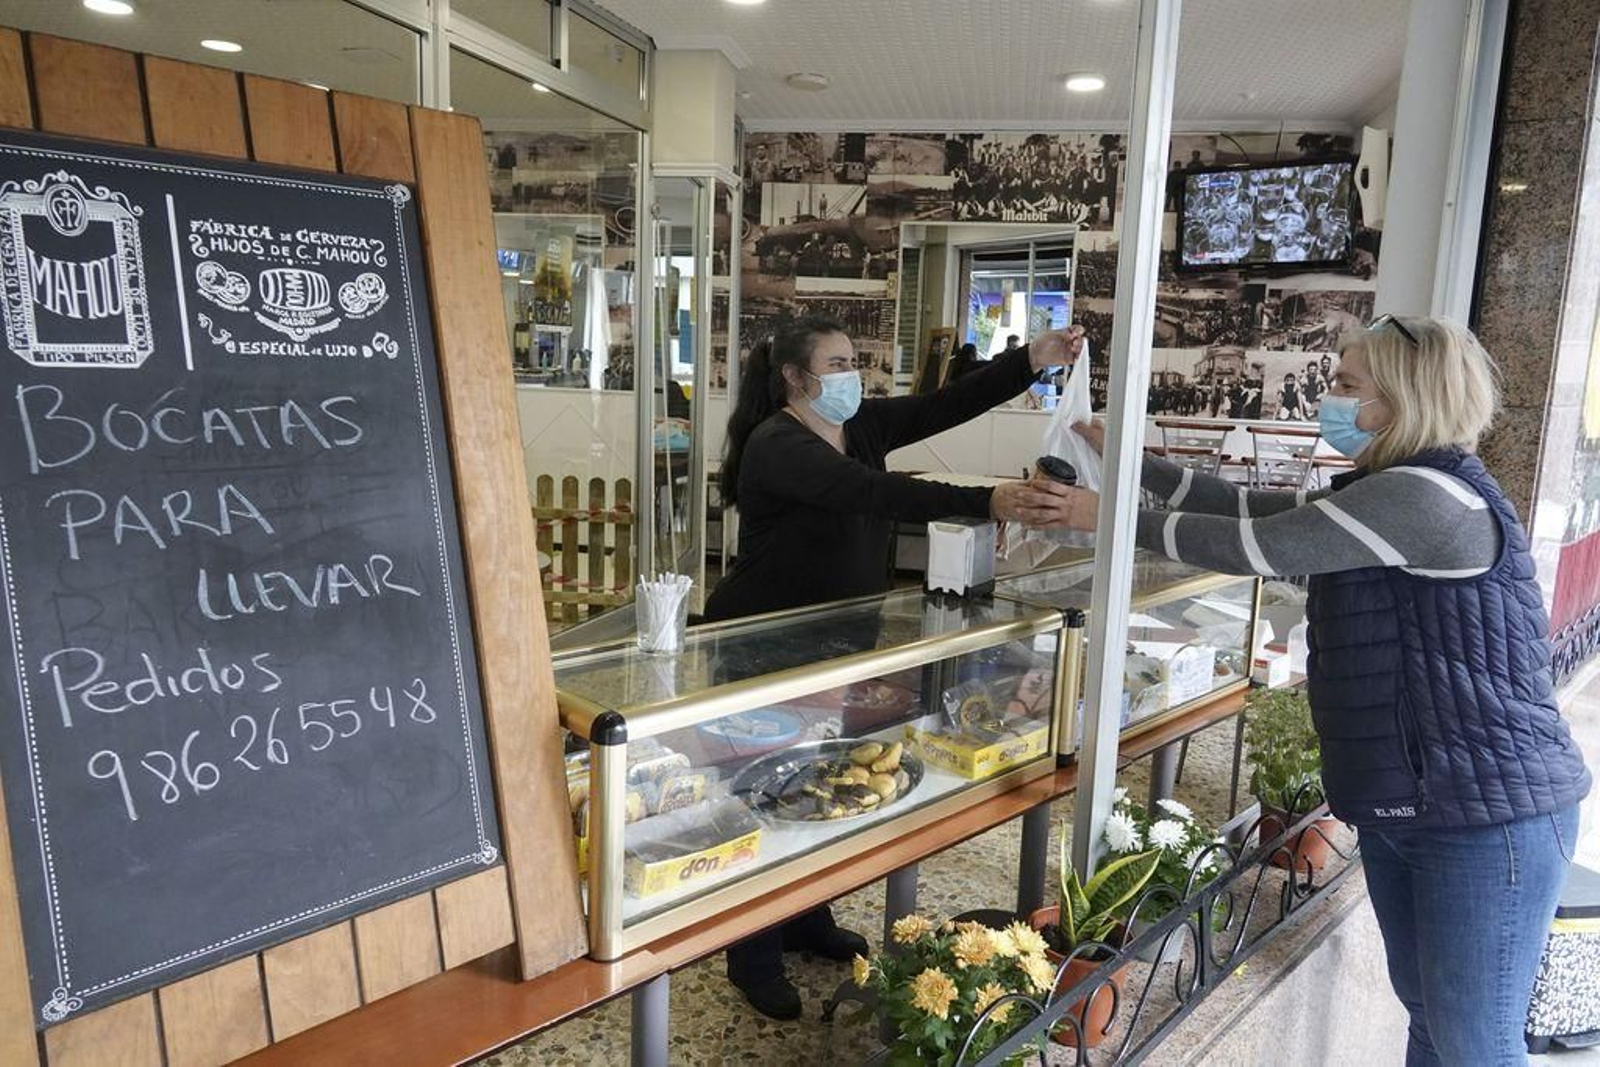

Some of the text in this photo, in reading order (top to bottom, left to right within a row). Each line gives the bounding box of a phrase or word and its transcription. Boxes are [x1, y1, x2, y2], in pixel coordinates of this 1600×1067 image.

[121, 218, 137, 280] ESPECIAL
[210, 236, 370, 264] HIJOS DE C. MAHOU
[295, 228, 371, 250] CERVEZA
[5, 268, 19, 287] DE
[26, 245, 123, 319] MAHOU
[279, 317, 316, 326] MADRID
[39, 352, 136, 363] TIPO PILSEN
[239, 341, 310, 356] ESPECIAL
[325, 345, 357, 357] LUJO
[16, 384, 363, 473] BOCATAS
[45, 484, 275, 559] PARA
[198, 554, 421, 621] LLEVAR
[39, 647, 282, 727] Pedidos
[1374, 808, 1390, 818] EL
